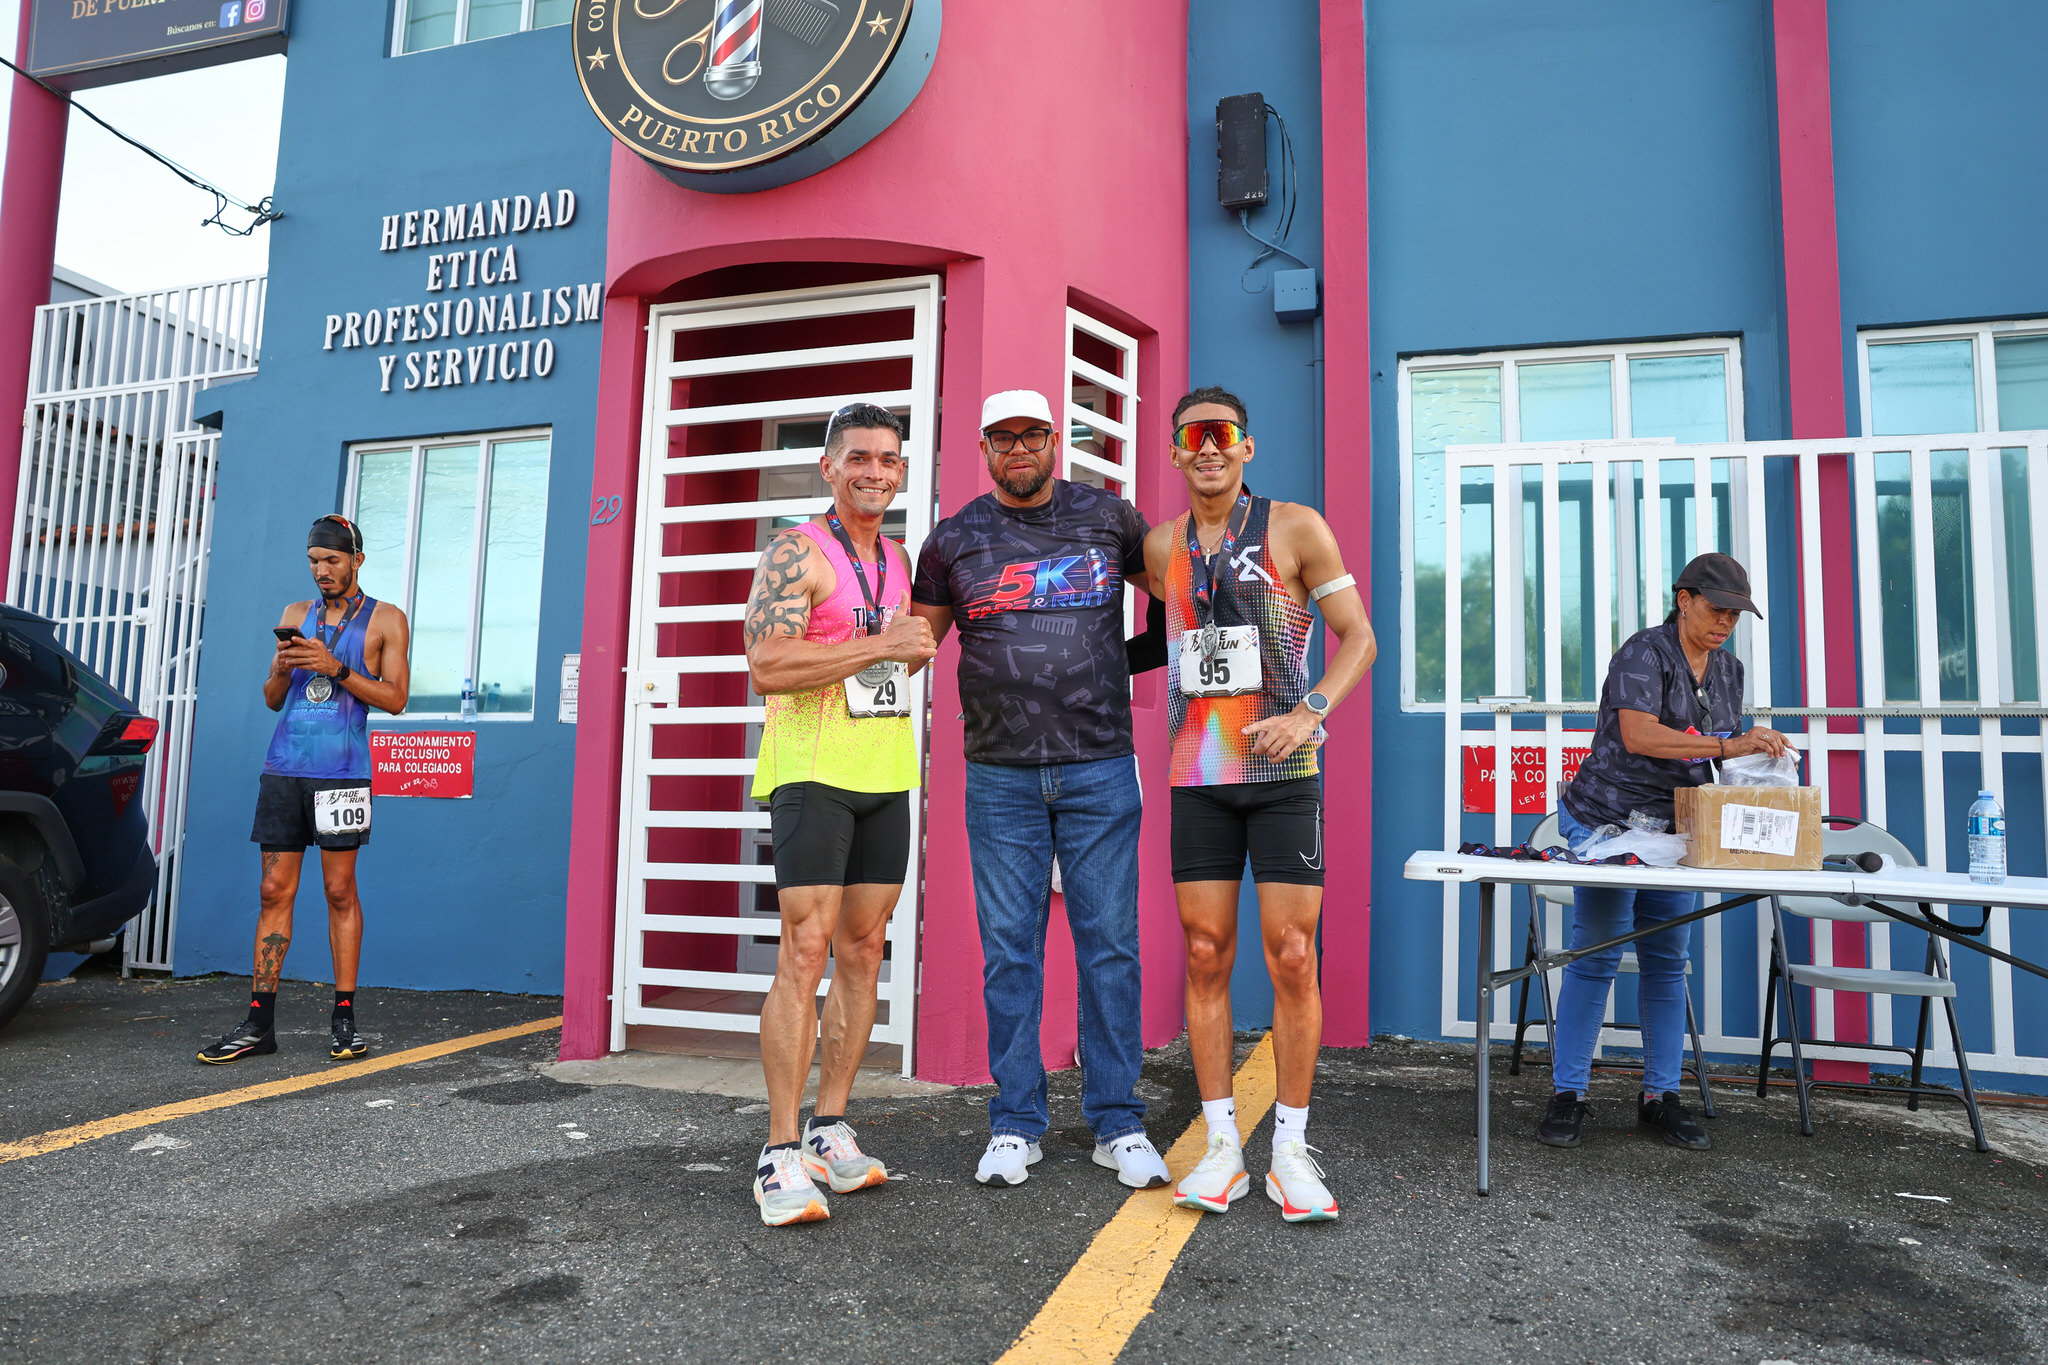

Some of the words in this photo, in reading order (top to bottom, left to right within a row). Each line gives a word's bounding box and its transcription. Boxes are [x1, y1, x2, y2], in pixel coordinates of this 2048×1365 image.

[71, 0, 99, 19] DE
[166, 21, 203, 36] Búscanos
[618, 104, 748, 155] PUERTO
[758, 83, 842, 145] RICO
[379, 189, 577, 252] HERMANDAD
[426, 244, 519, 292] ETICA
[378, 355, 397, 393] Y
[404, 338, 556, 391] SERVICIO
[591, 494, 623, 527] 29
[990, 555, 1085, 602] 5K
[967, 598, 1031, 620] FADE
[1051, 592, 1104, 608] RUN
[1199, 658, 1231, 686] 95
[873, 679, 897, 706] 29
[372, 735, 472, 748] ESTACIONAMIENTO
[390, 748, 451, 760] EXCLUSIVO
[1511, 751, 1593, 766] XCLSIV
[378, 762, 402, 773] PARA
[404, 762, 462, 774] COLEGIADOS
[1480, 769, 1518, 783] PAA
[339, 790, 360, 798] FADE
[400, 782, 412, 791] LEY
[1518, 793, 1537, 806] LEY
[330, 807, 365, 827] 109
